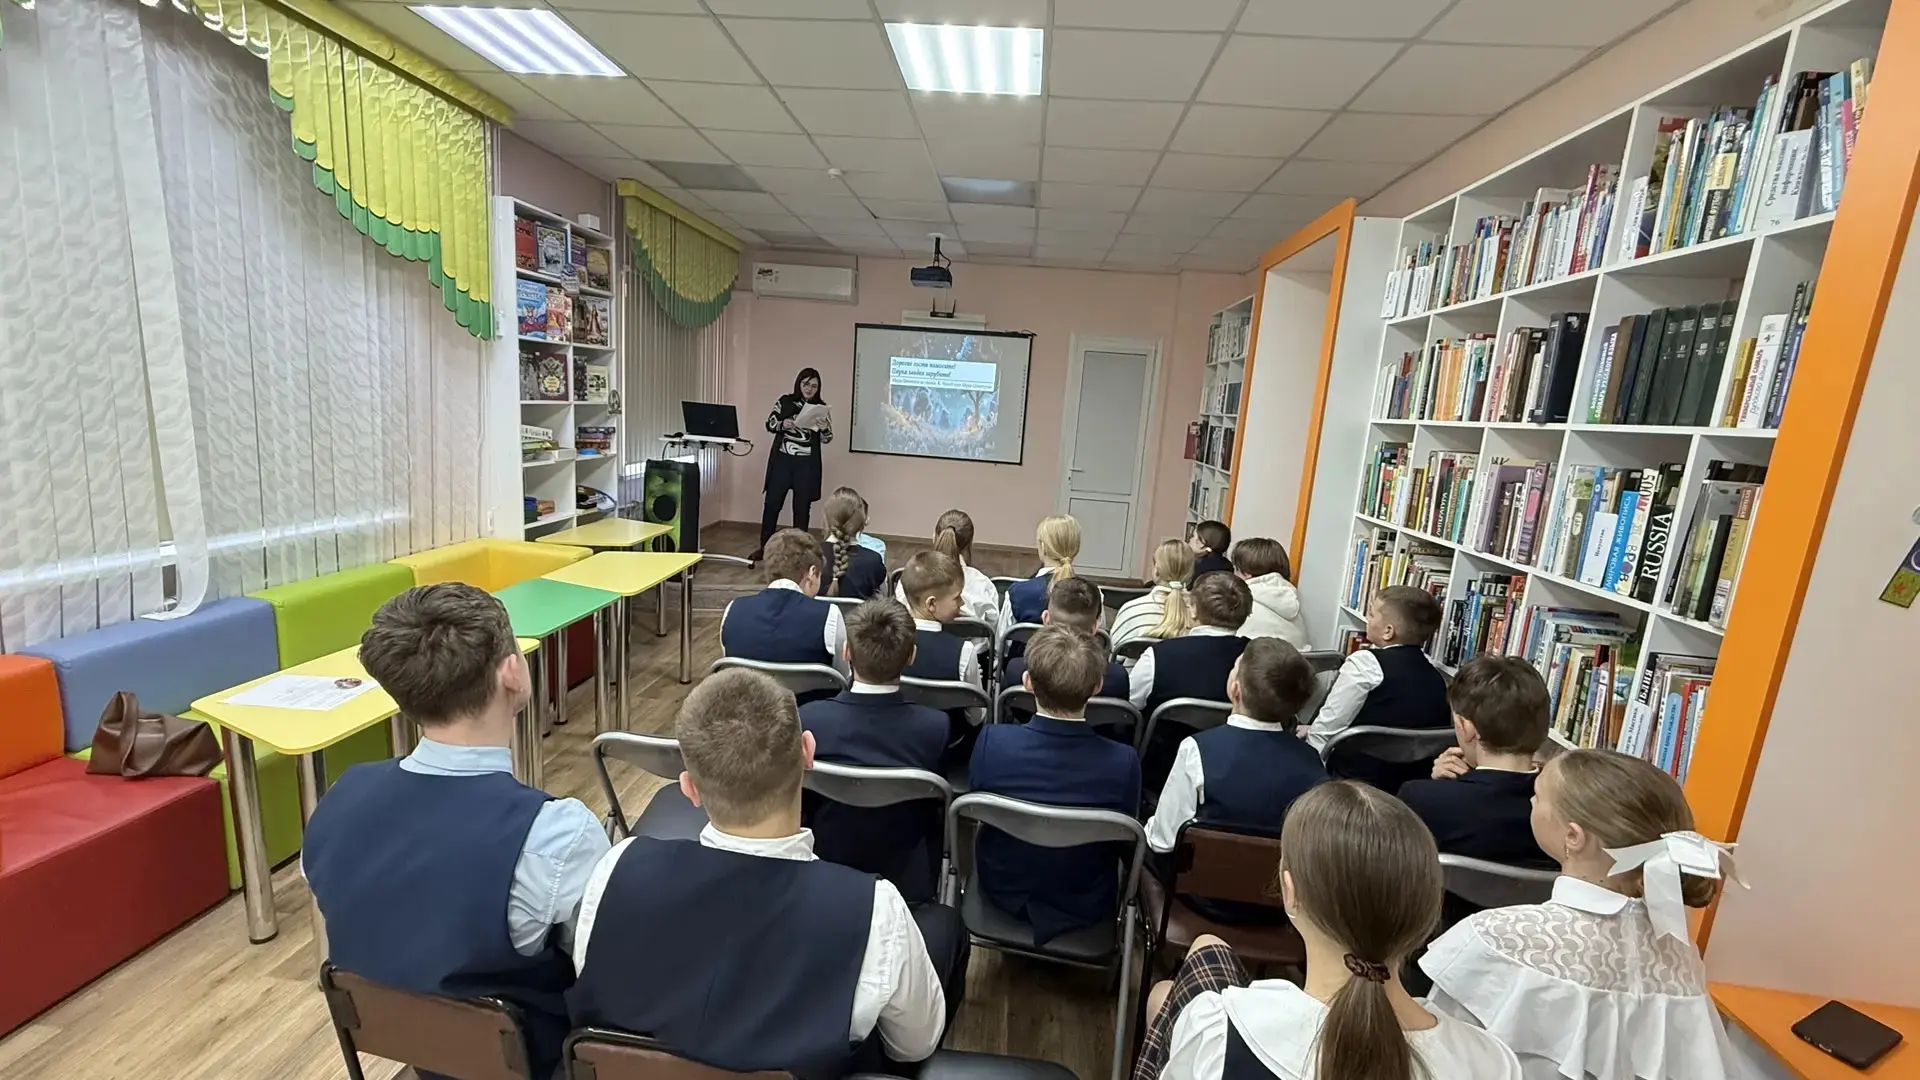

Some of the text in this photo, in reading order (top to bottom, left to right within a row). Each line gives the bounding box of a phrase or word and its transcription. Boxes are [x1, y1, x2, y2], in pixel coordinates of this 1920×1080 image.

[1765, 138, 1789, 206] Средства массов
[1594, 331, 1618, 418] СЛОВАРЬ РУССКОГО ЯЗЫКА
[1598, 342, 1609, 377] ТОЛКОВЫЙ
[1752, 349, 1764, 374] СЛОВАРЬ
[1640, 474, 1655, 497] 500
[1605, 495, 1632, 588] МИРОВАЯ ЖИВОПИСЬ
[1641, 513, 1673, 581] RUSSIA
